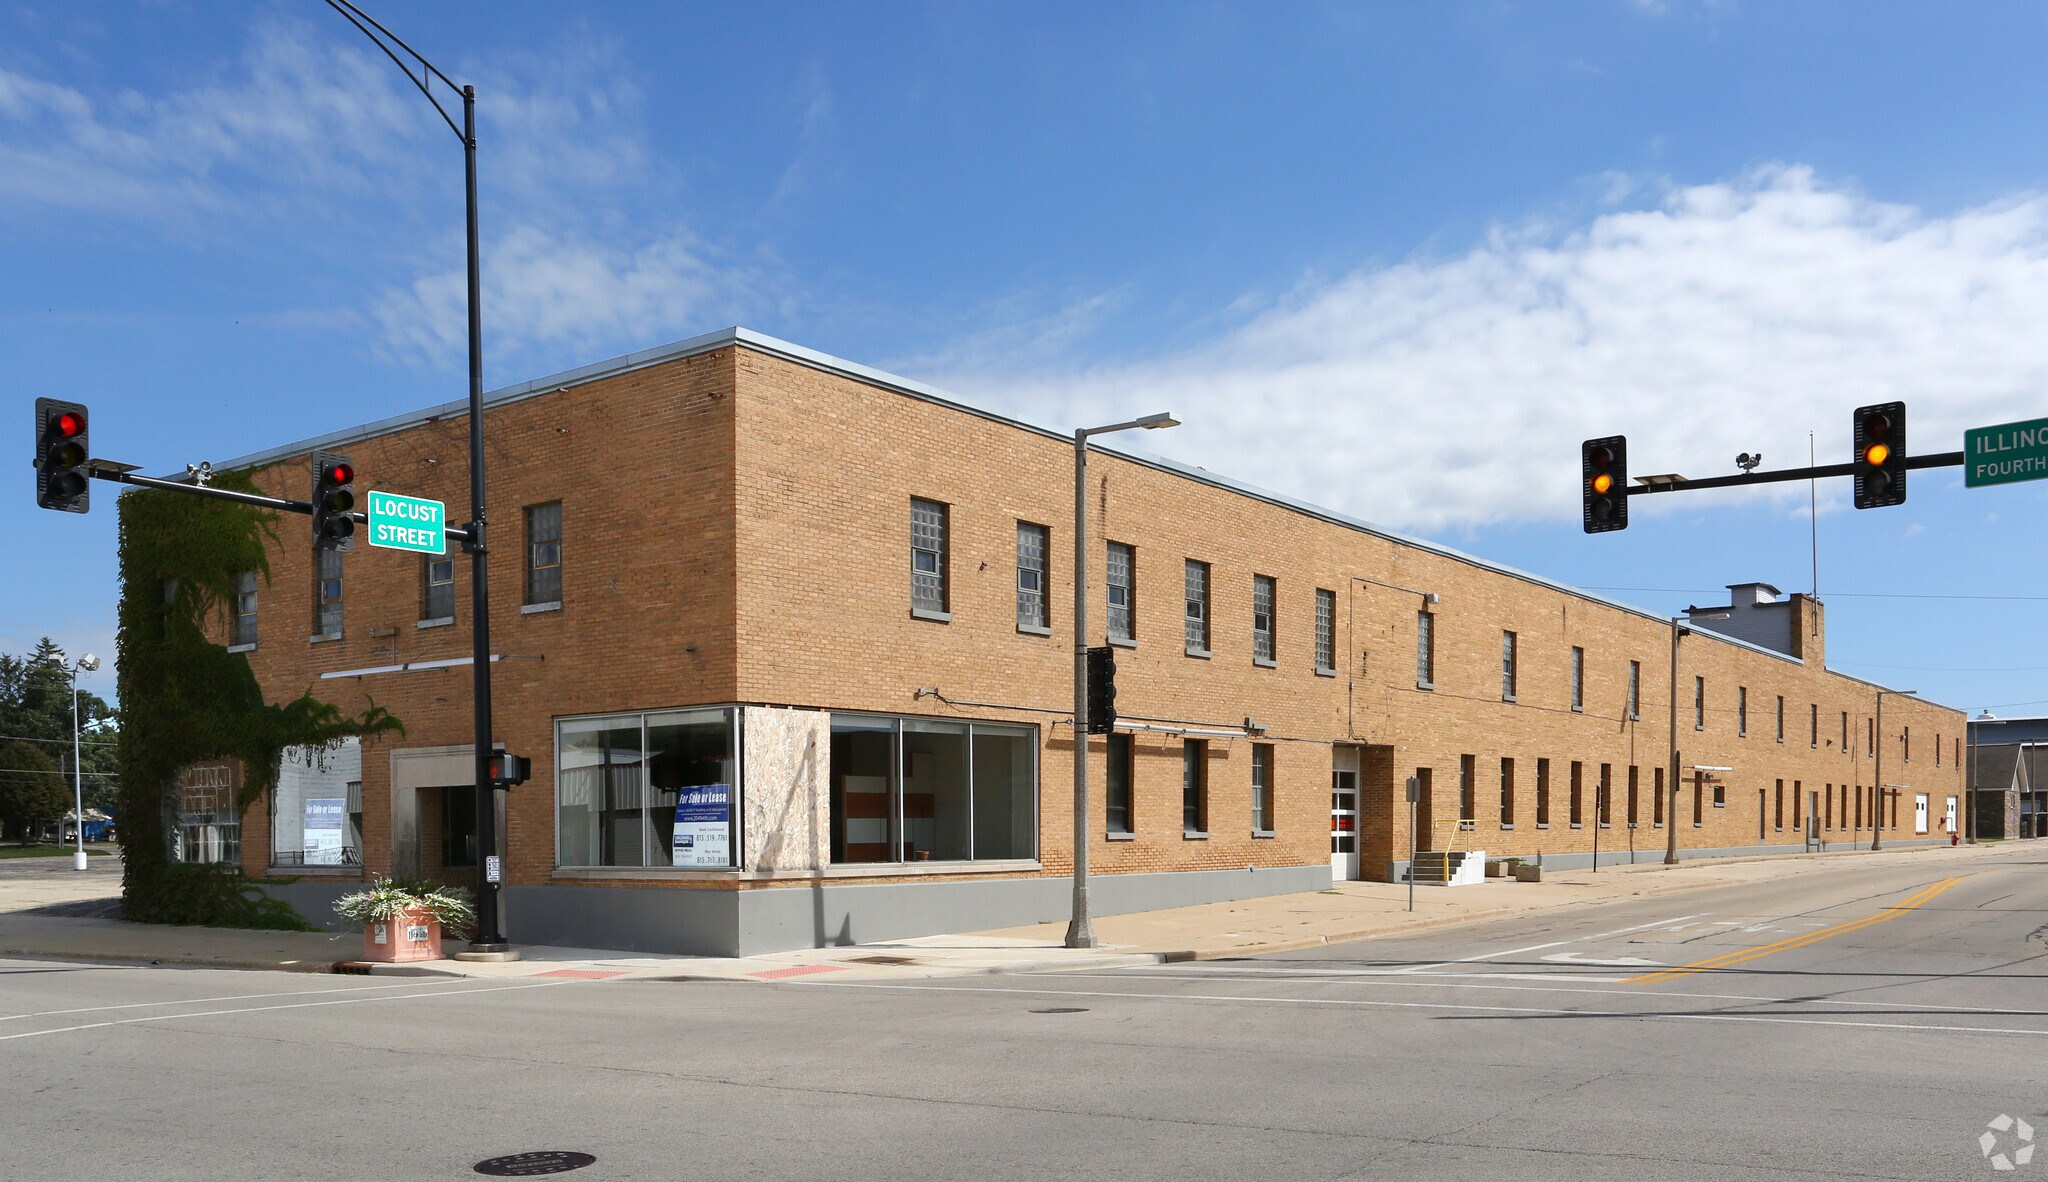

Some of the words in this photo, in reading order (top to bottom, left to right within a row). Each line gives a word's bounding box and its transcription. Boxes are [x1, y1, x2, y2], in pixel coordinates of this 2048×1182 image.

[1976, 456, 2046, 478] FOURTH
[375, 498, 438, 522] LOCUST
[377, 524, 436, 547] STREET
[313, 805, 322, 814] Sale
[328, 804, 342, 814] Lease
[679, 794, 688, 804] For
[688, 793, 701, 804] Sale
[701, 793, 708, 803] or
[708, 792, 727, 803] Lease
